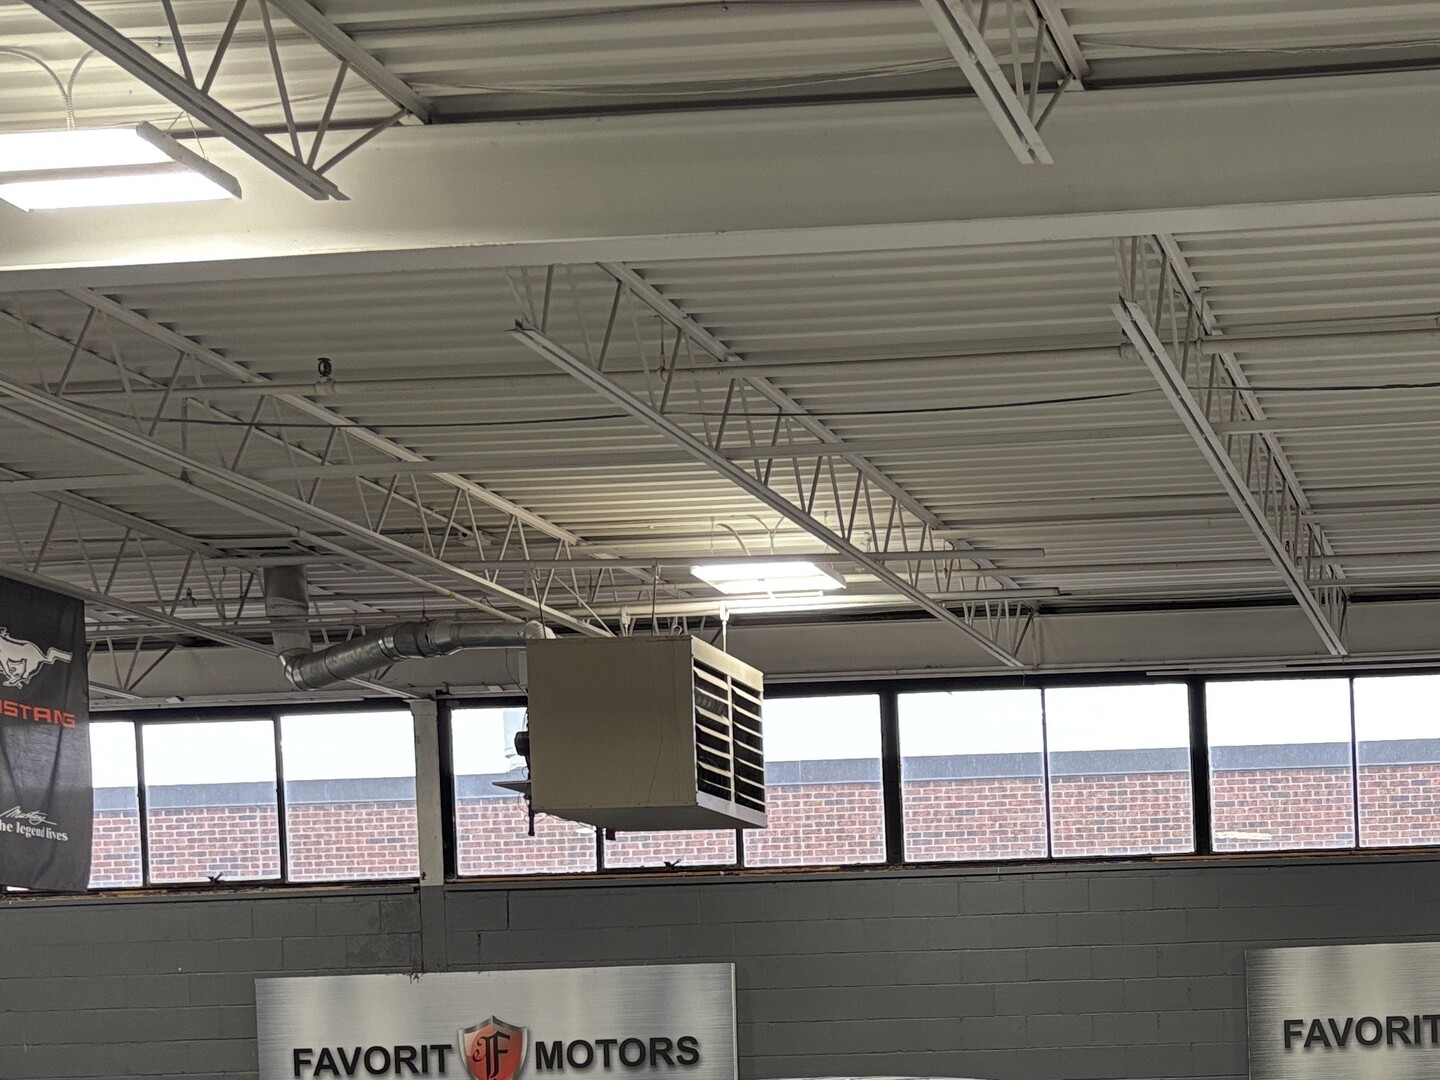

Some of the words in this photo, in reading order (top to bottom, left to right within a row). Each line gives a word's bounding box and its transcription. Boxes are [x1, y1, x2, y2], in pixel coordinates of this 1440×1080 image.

[0, 699, 76, 728] STANG
[16, 821, 45, 838] legend
[46, 826, 69, 841] lives
[293, 1043, 453, 1077] FAVORIT
[535, 1035, 701, 1070] MOTORS
